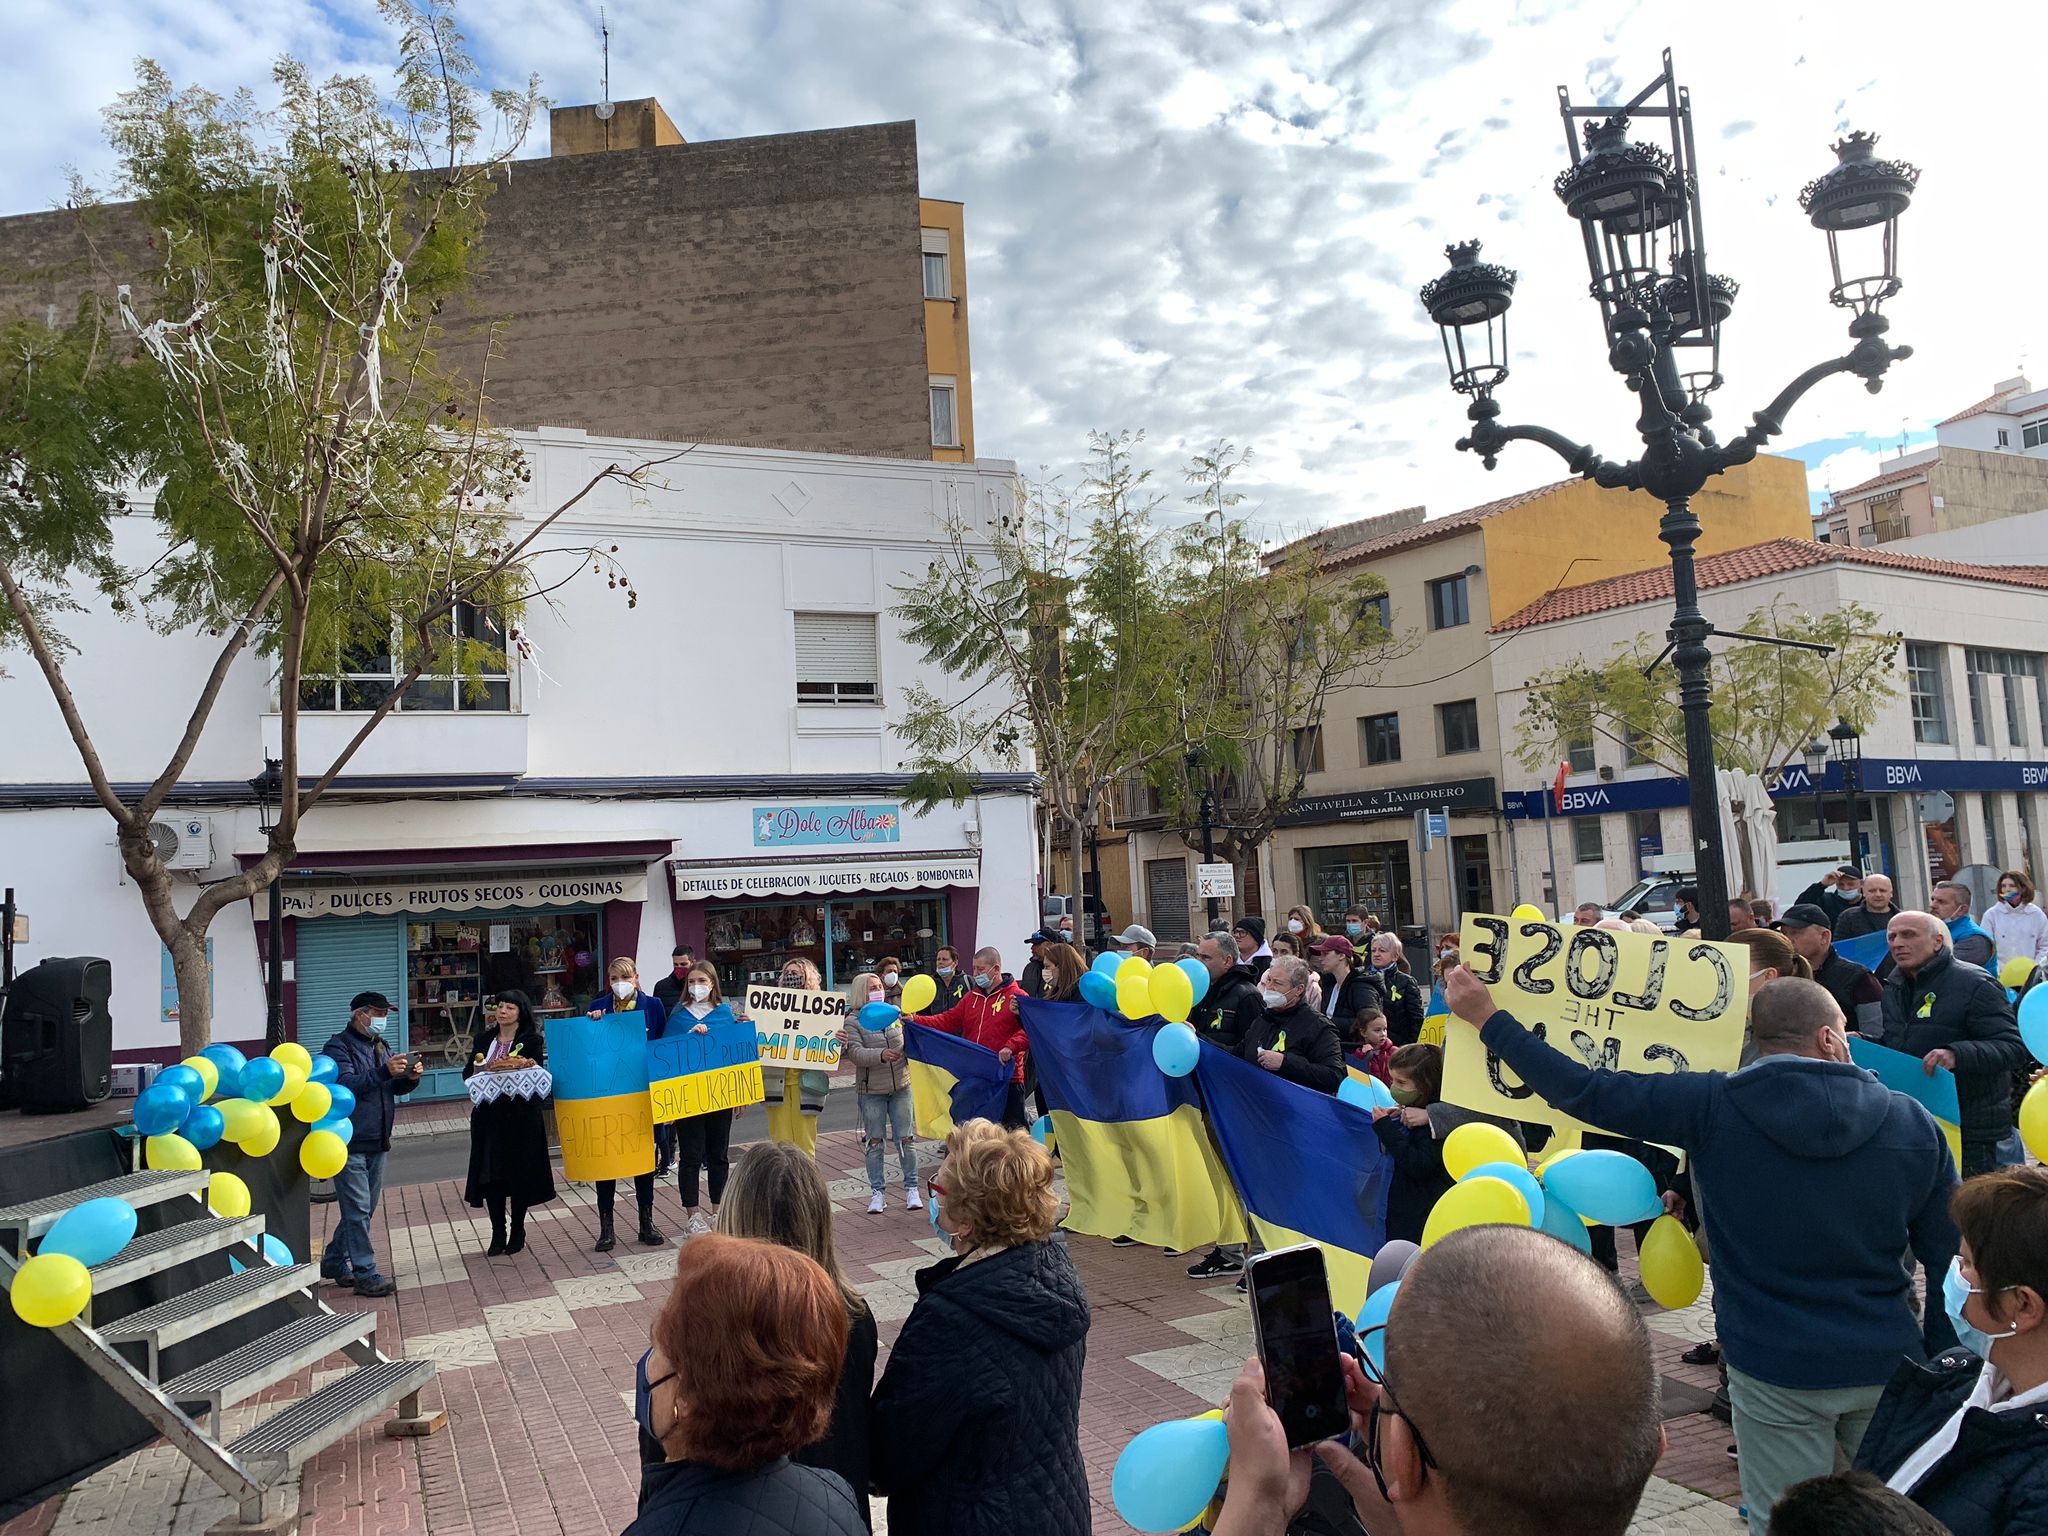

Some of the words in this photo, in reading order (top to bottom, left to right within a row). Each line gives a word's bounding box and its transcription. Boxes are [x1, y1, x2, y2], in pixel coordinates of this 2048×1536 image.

[1886, 765, 1922, 784] BBVA
[1370, 796, 1379, 805] &
[1384, 787, 1465, 804] TAMBORERO
[1507, 801, 1524, 810] BBVA
[1562, 789, 1610, 810] BBVA
[1340, 806, 1404, 817] INMOBILIARIA
[777, 808, 822, 838] Dolç
[826, 808, 876, 841] Alba
[682, 879, 728, 892] DETALLES
[731, 878, 743, 889] DE
[746, 875, 810, 889] CELEBRACION
[818, 873, 861, 886] JUGUETES
[869, 871, 909, 883] REGALOS
[917, 869, 974, 882] BOMBONERIA
[282, 895, 313, 910] PAN
[331, 892, 393, 908] DULCES
[409, 889, 469, 904] FRUTOS
[475, 886, 524, 901] SECOS
[539, 881, 623, 897] GOLOSINAS
[750, 991, 846, 1016] ORGULLOSA
[783, 1018, 800, 1030] DE
[653, 1033, 715, 1078] STOP
[721, 1040, 759, 1065] PUTIN
[758, 1031, 790, 1059] MI
[792, 1030, 842, 1064] PAÍS
[591, 1057, 642, 1094] LA
[652, 1084, 691, 1119] SAVE
[696, 1066, 764, 1113] UKRAINE
[559, 1111, 650, 1159] GUERRA
